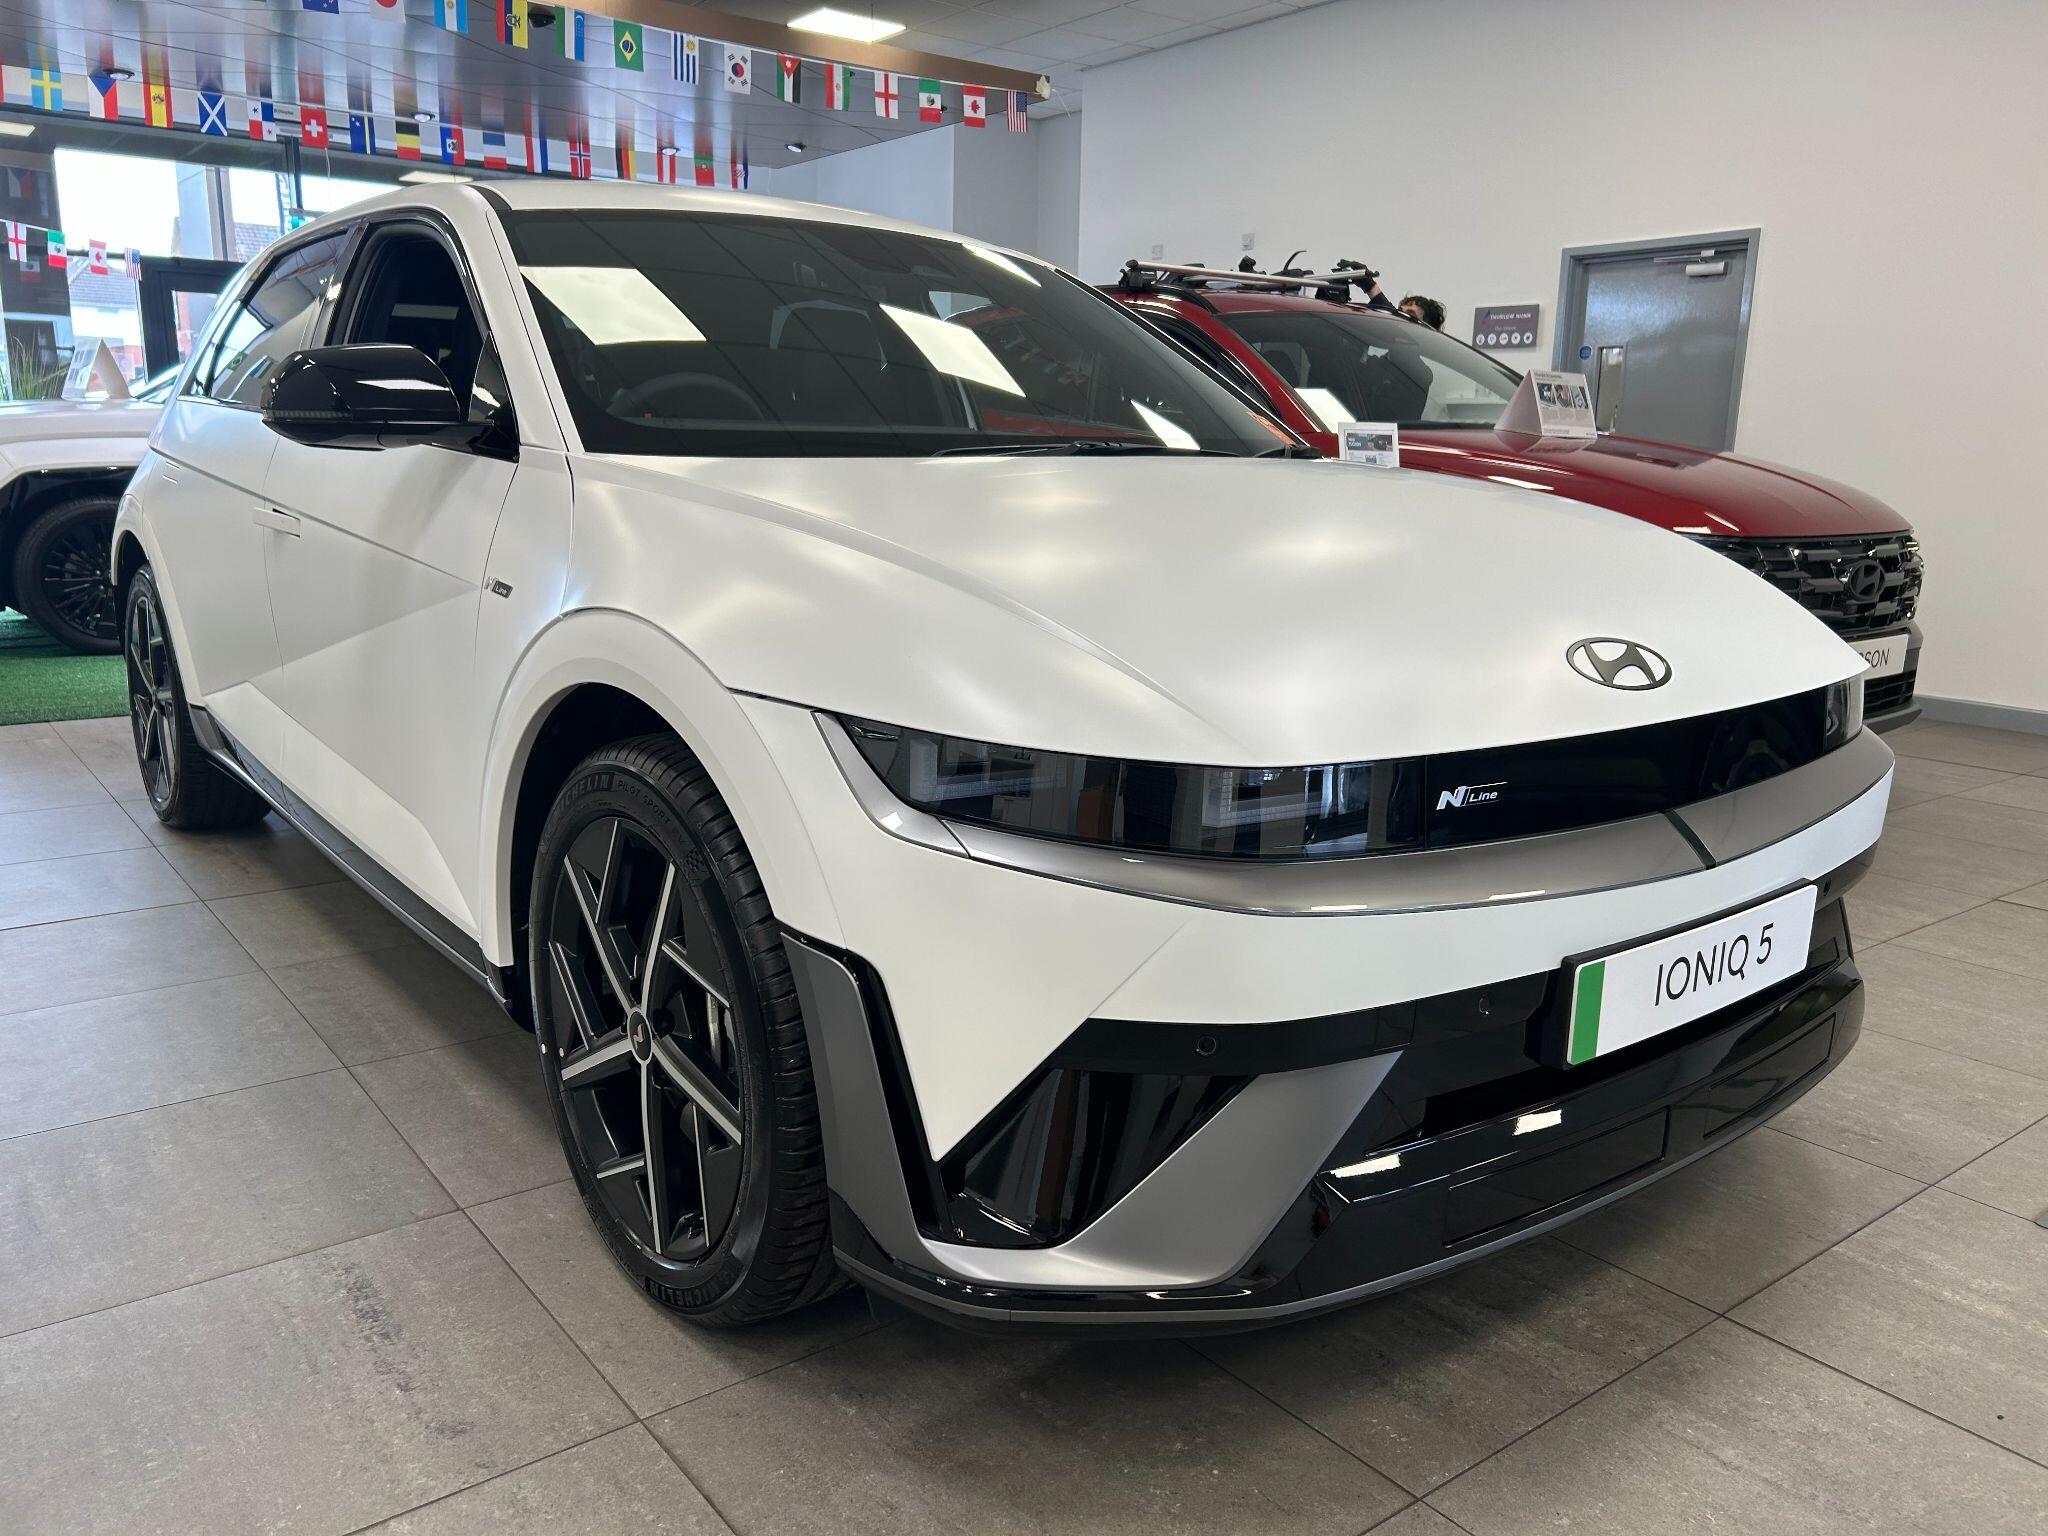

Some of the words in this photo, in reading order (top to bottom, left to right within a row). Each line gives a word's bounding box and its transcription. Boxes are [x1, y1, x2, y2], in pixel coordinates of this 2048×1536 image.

[1859, 648, 1889, 668] SON
[617, 780, 641, 797] PILOT
[643, 795, 670, 824] SPORT
[1436, 785, 1468, 810] N
[1469, 791, 1498, 803] Line
[1655, 934, 1749, 1007] IONIQ
[1756, 922, 1775, 965] 5
[649, 1281, 720, 1307] MICHELIN
